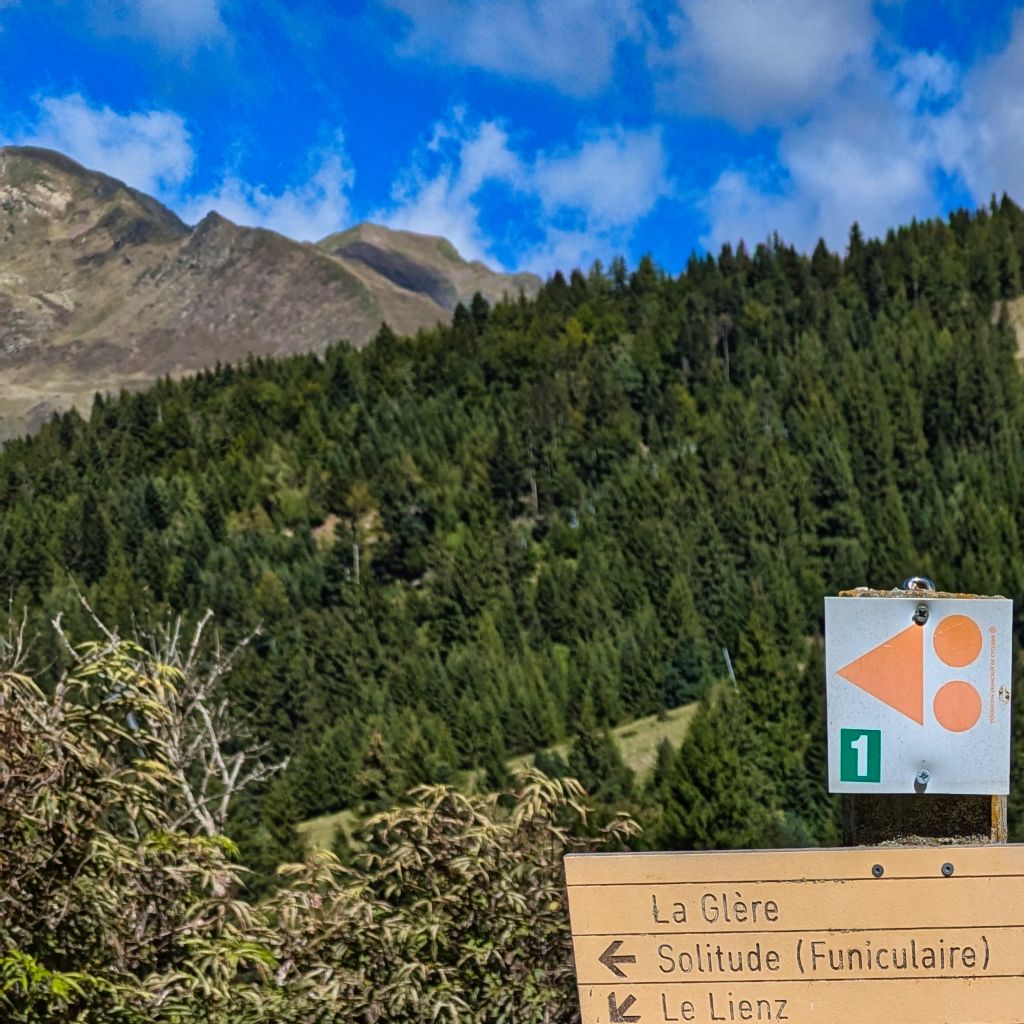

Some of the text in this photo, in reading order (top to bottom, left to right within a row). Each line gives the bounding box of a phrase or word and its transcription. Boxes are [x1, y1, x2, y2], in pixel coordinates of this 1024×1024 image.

[851, 735, 868, 776] 1
[652, 891, 779, 924] La Glère
[658, 935, 990, 974] Solitude (Funiculaire)
[662, 992, 789, 1021] Le Lienz
